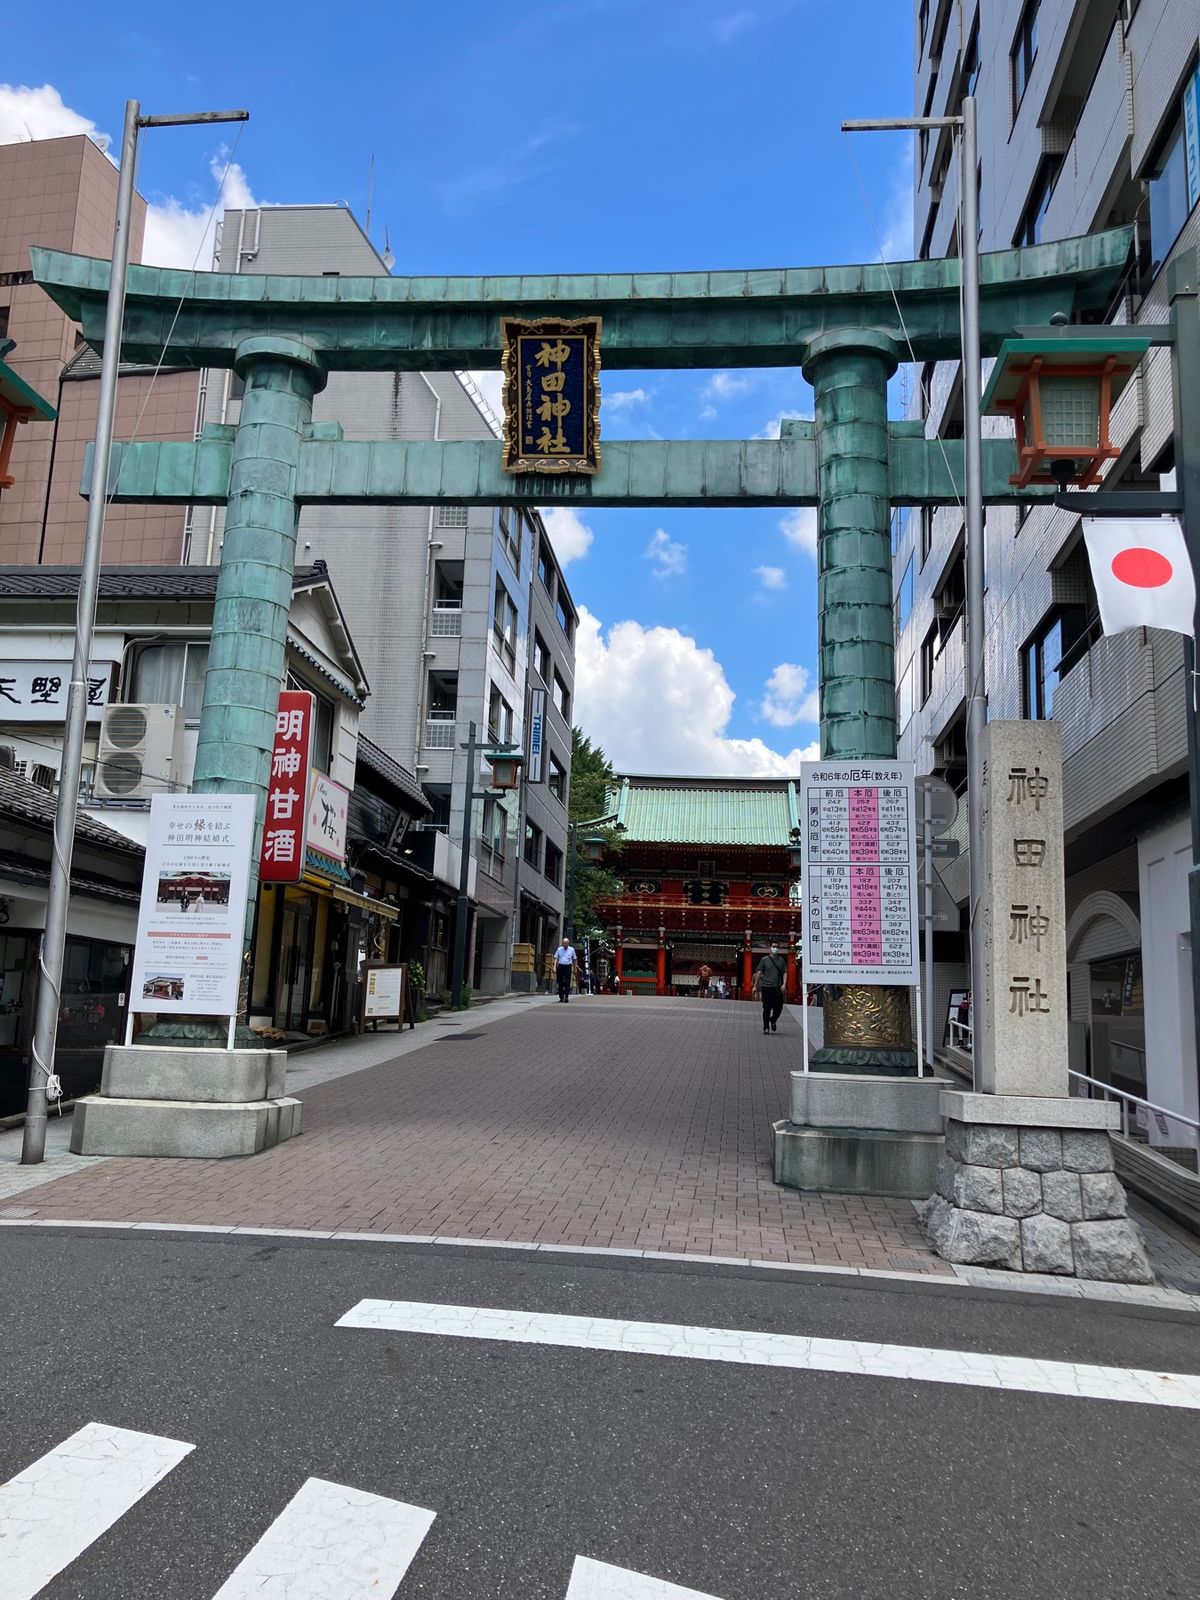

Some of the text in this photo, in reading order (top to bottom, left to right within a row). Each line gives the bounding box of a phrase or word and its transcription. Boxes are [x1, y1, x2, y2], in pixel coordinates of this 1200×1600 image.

[534, 339, 571, 453] 神田神社
[532, 714, 542, 755] TAIMEI
[811, 769, 902, 781] 令和6年の厄年(数え年)
[265, 709, 304, 862] 明神甘酒
[826, 789, 844, 798] 前厄
[854, 789, 873, 798] 本厄
[883, 788, 902, 797] 後厄
[169, 818, 231, 831] 幸せの縁を結ぶ
[810, 806, 819, 854] 男の厄年
[167, 834, 230, 843] 神田明神結婚式
[826, 867, 845, 876] 前厄
[855, 867, 875, 876] 本厄
[884, 867, 904, 876] 後厄
[1007, 766, 1050, 1017] 神田神社
[810, 894, 820, 943] 女の厄年
